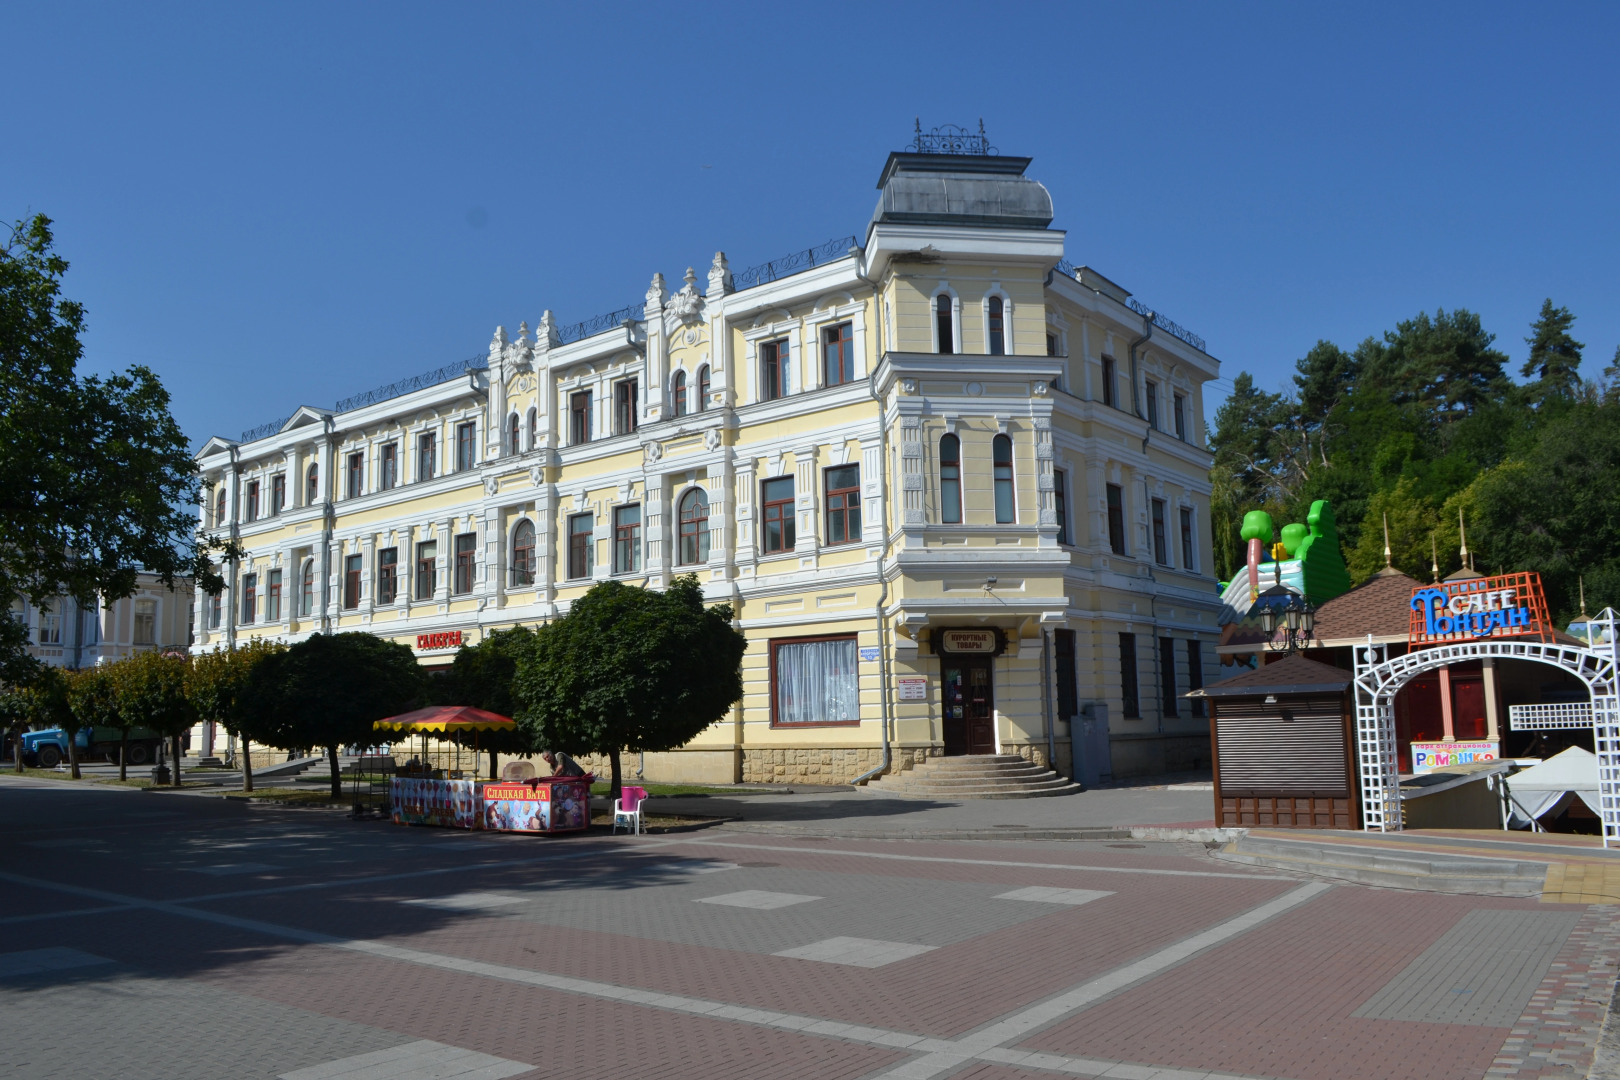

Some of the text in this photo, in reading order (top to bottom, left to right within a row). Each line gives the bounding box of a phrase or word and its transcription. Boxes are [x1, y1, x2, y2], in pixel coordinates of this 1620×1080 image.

[417, 631, 461, 648] ГАЛЕРЕЯ
[951, 634, 987, 642] КУРОРТНЫЕ
[957, 641, 982, 649] ТОВАРЫ
[430, 807, 456, 817] FRESH
